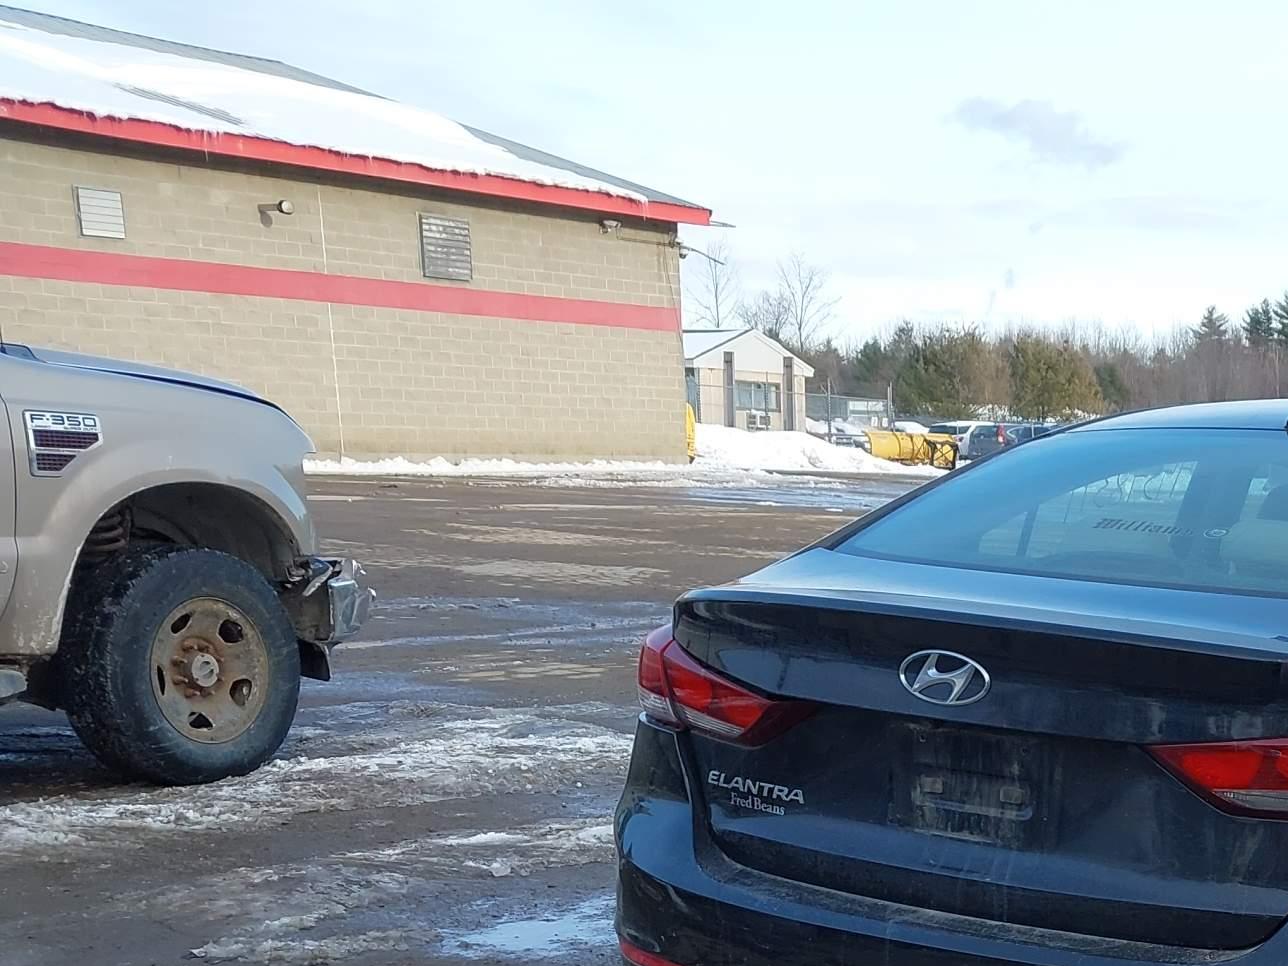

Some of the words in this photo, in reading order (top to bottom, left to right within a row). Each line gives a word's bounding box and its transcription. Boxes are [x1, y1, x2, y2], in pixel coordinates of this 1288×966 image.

[708, 770, 804, 804] ELANTRA
[731, 792, 752, 809] Fred
[754, 798, 785, 815] Beans
